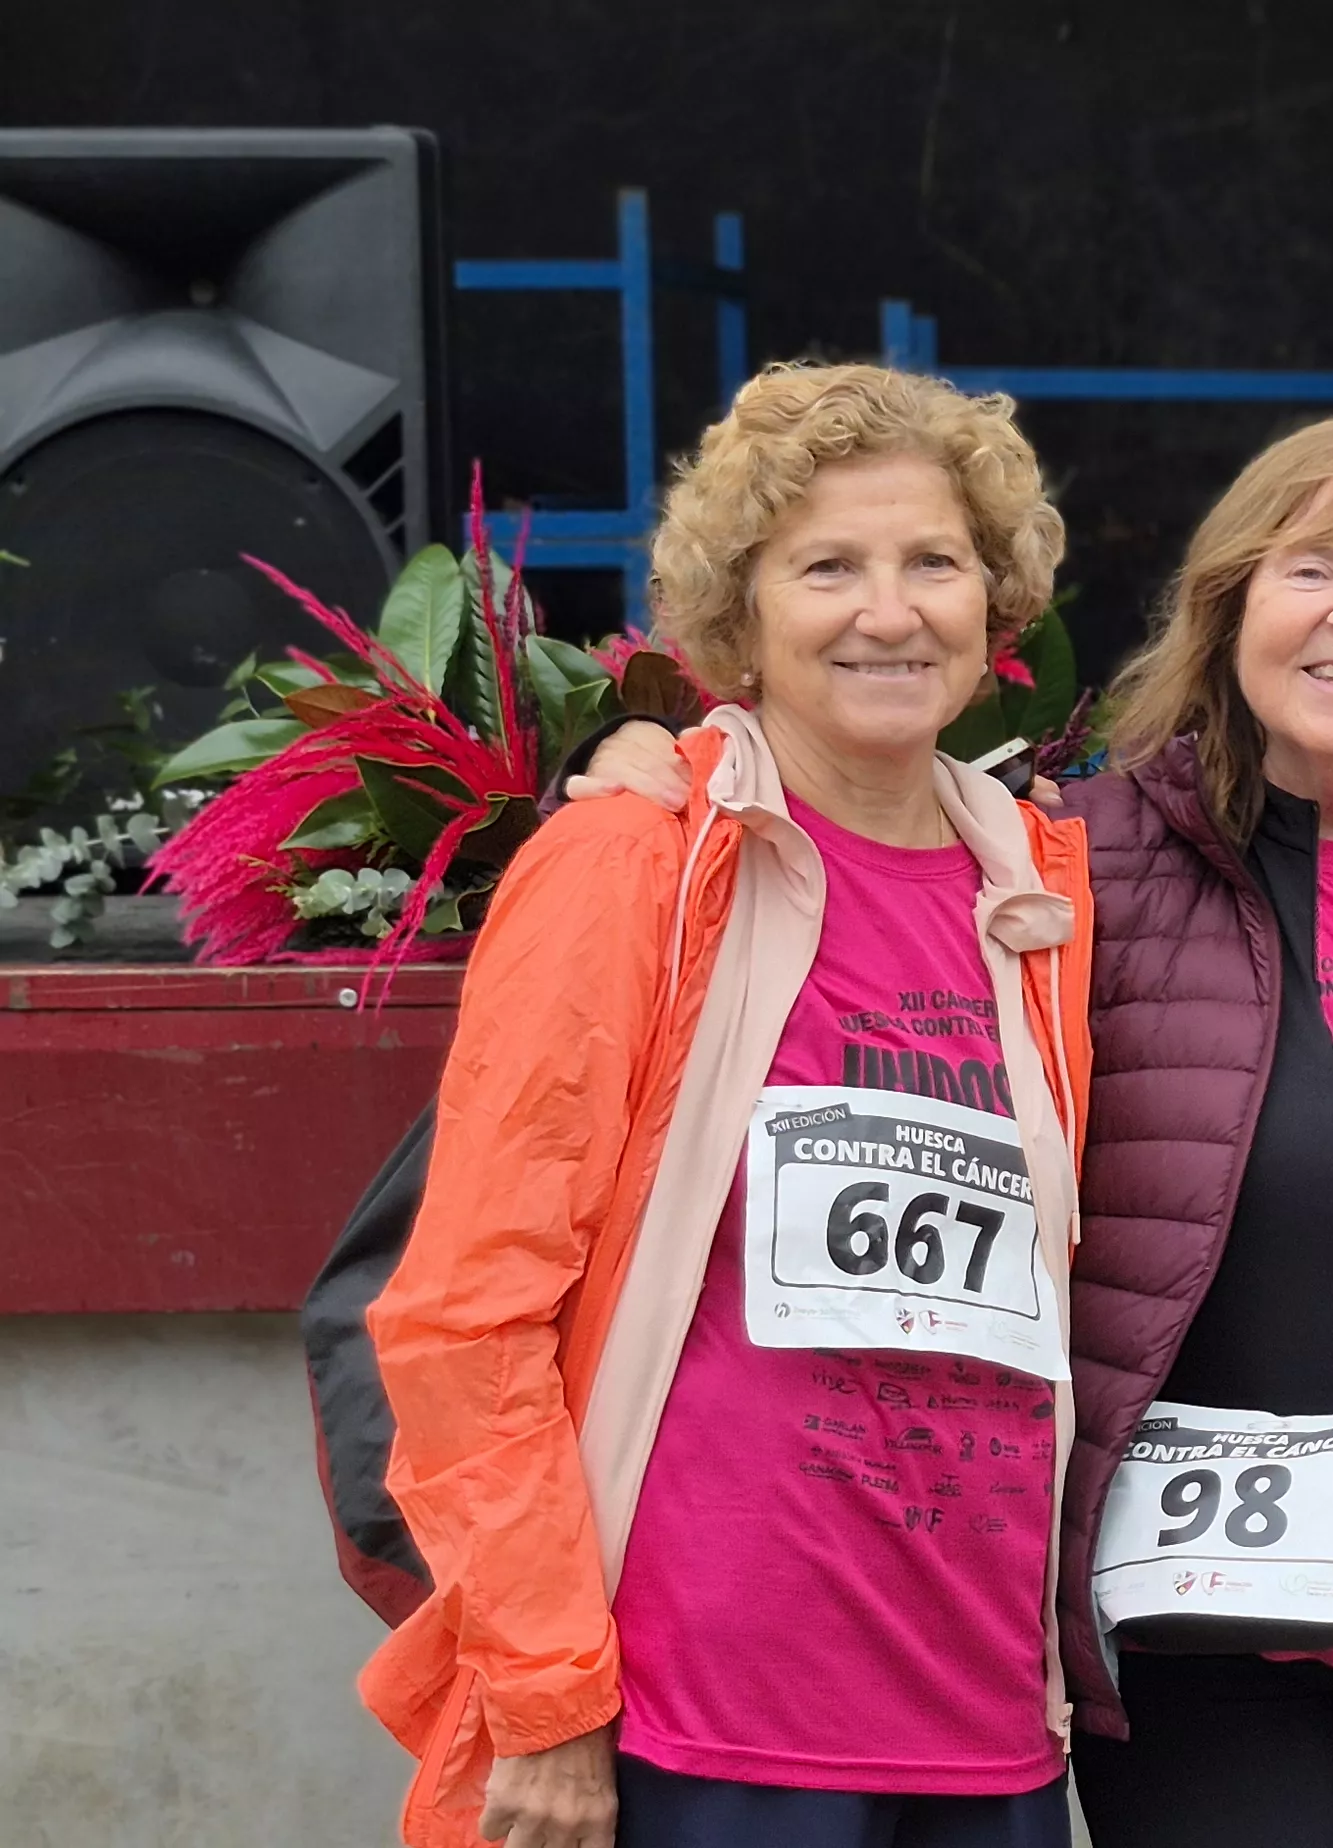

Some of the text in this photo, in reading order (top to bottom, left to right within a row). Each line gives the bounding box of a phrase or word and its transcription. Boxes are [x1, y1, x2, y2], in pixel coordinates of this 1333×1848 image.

[897, 991, 925, 1012] XII
[771, 1108, 847, 1133] XII EDICIÓN
[896, 1124, 966, 1154] HUESCA
[793, 1137, 1033, 1200] CONTRA EL CÁNCER
[826, 1181, 1006, 1293] 667
[1212, 1432, 1289, 1446] HUESCA
[1229, 1446, 1258, 1459] EL
[1157, 1463, 1292, 1548] 98
